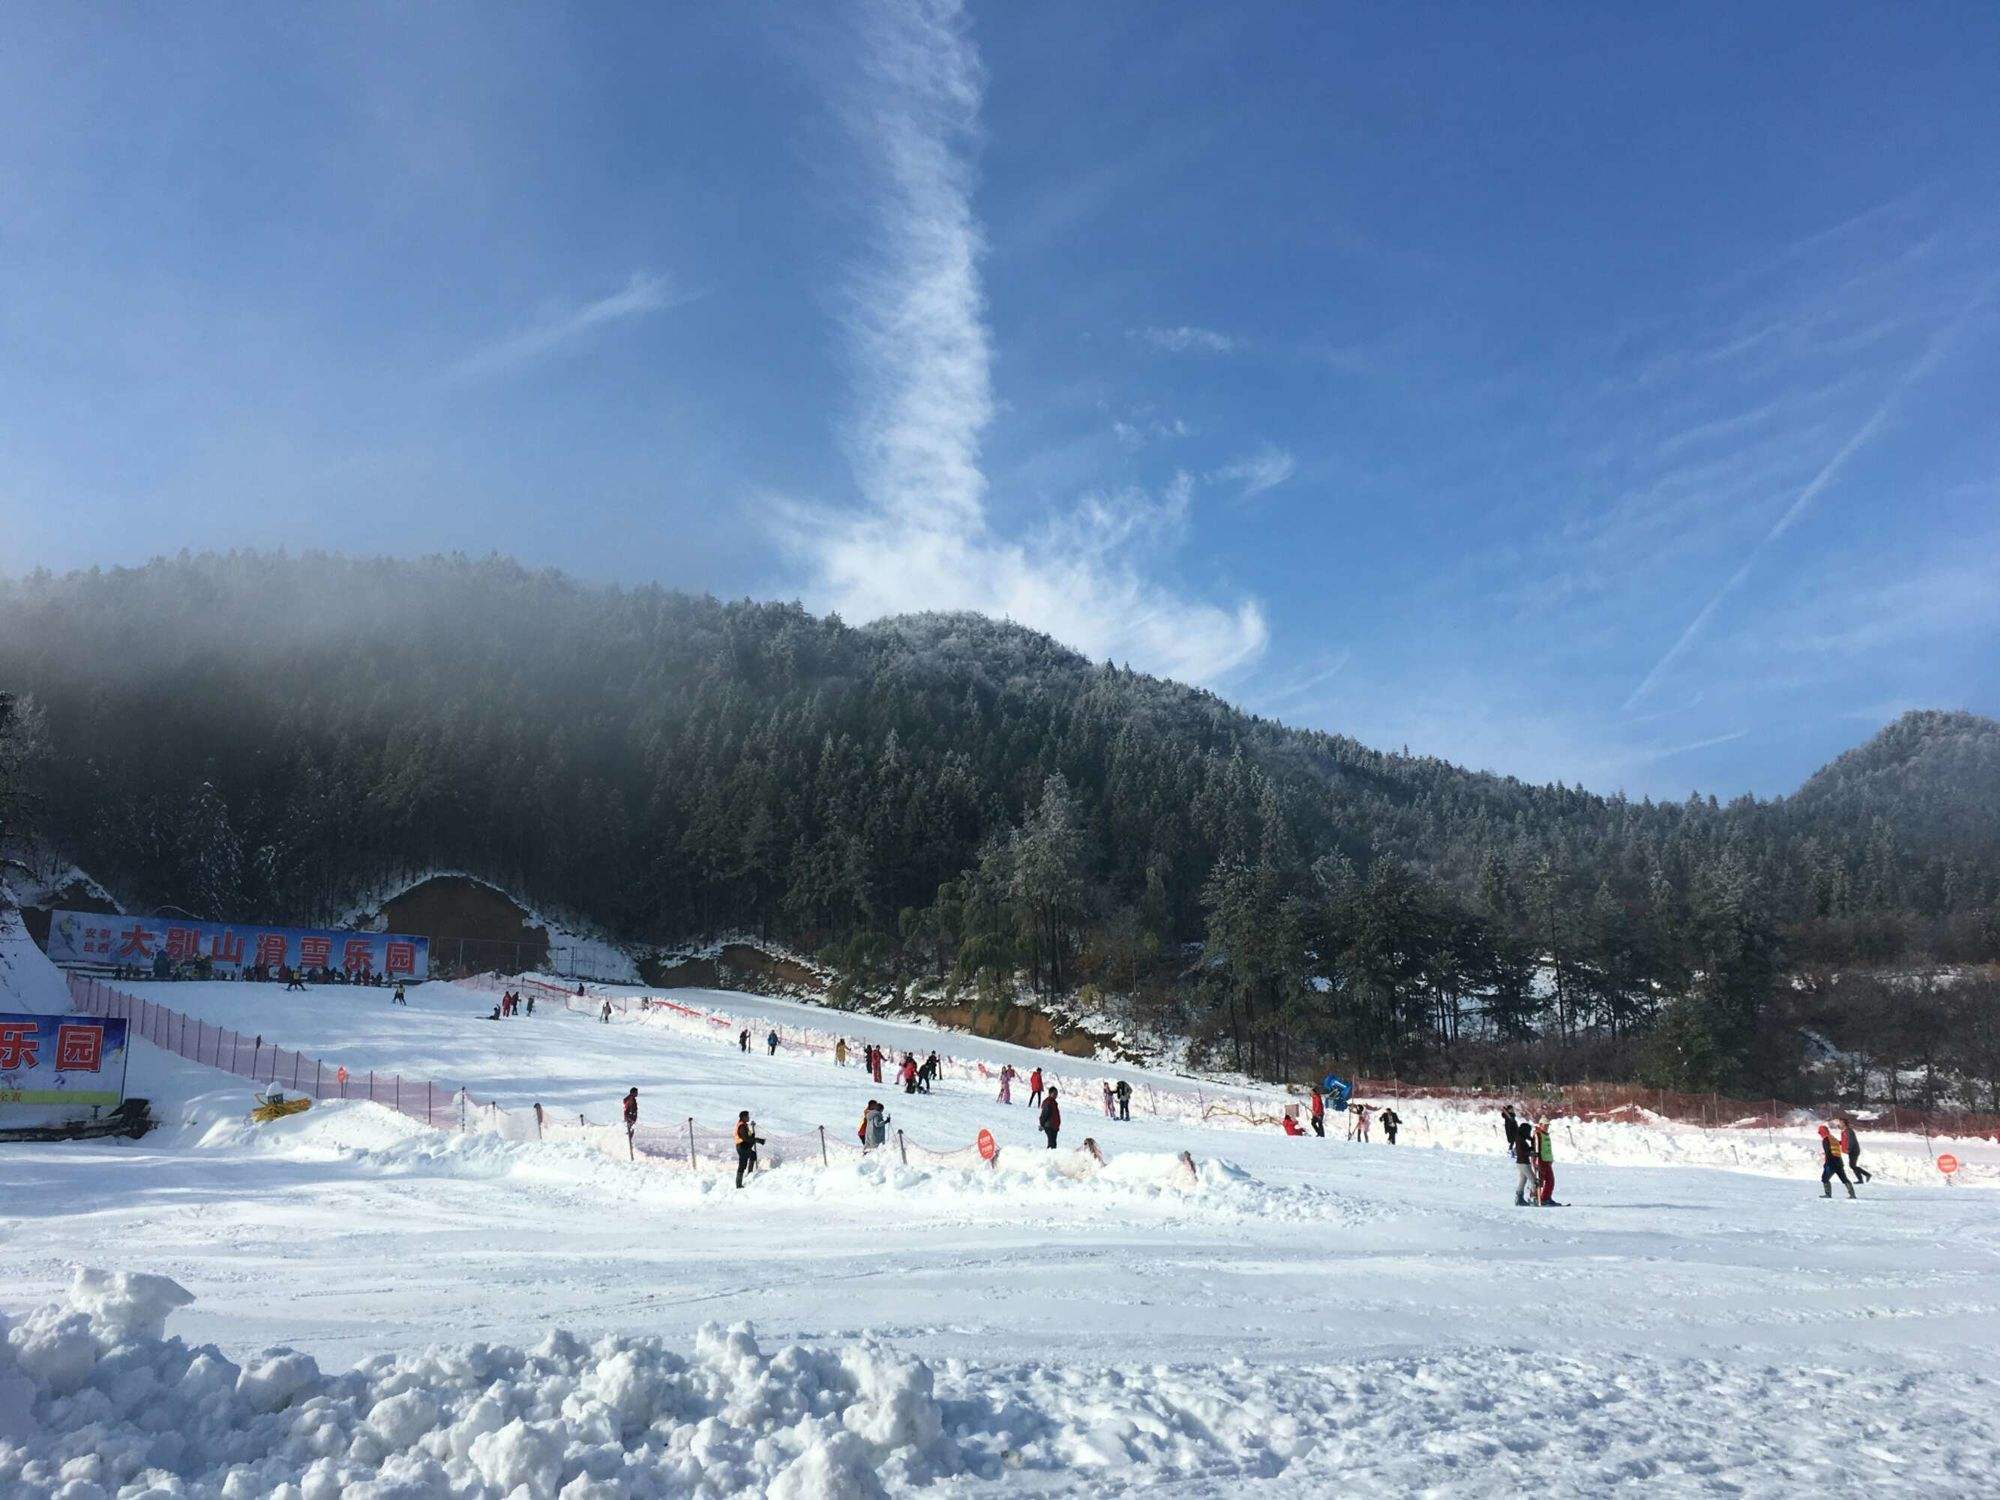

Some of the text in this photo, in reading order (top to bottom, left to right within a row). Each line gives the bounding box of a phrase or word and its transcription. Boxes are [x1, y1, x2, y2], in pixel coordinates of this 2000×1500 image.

[119, 924, 416, 975] 大别山滑雪乐园
[0, 1022, 104, 1073] 乐园
